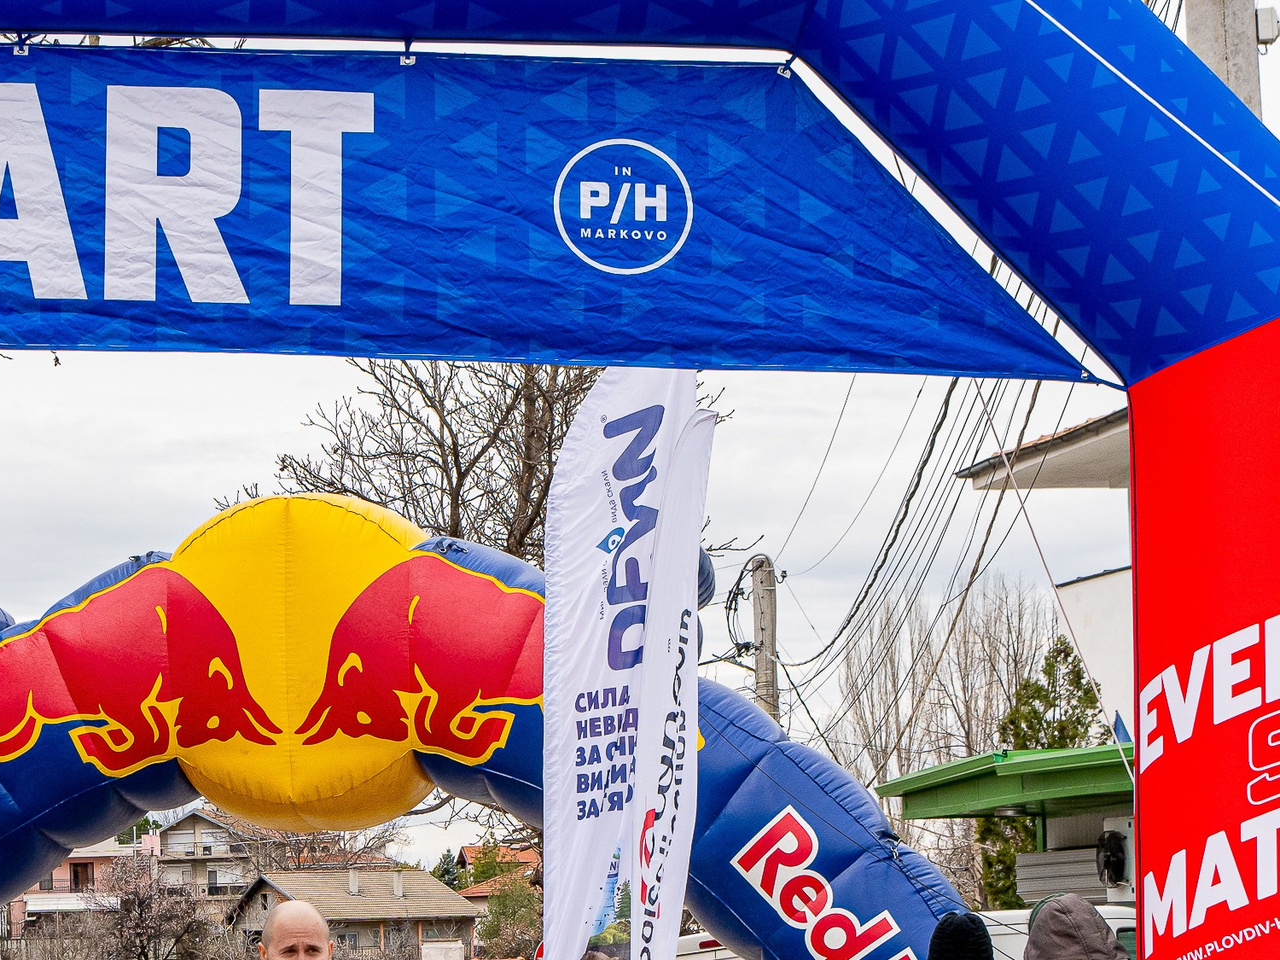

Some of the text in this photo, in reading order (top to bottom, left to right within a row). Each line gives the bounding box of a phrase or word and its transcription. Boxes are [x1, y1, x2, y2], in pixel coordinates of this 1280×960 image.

[614, 166, 632, 176] IN
[579, 181, 667, 224] P/H
[580, 228, 667, 240] MARKOVO
[575, 685, 630, 713] СИЛА
[1140, 614, 1280, 775] EVE
[575, 745, 601, 766] ЗА
